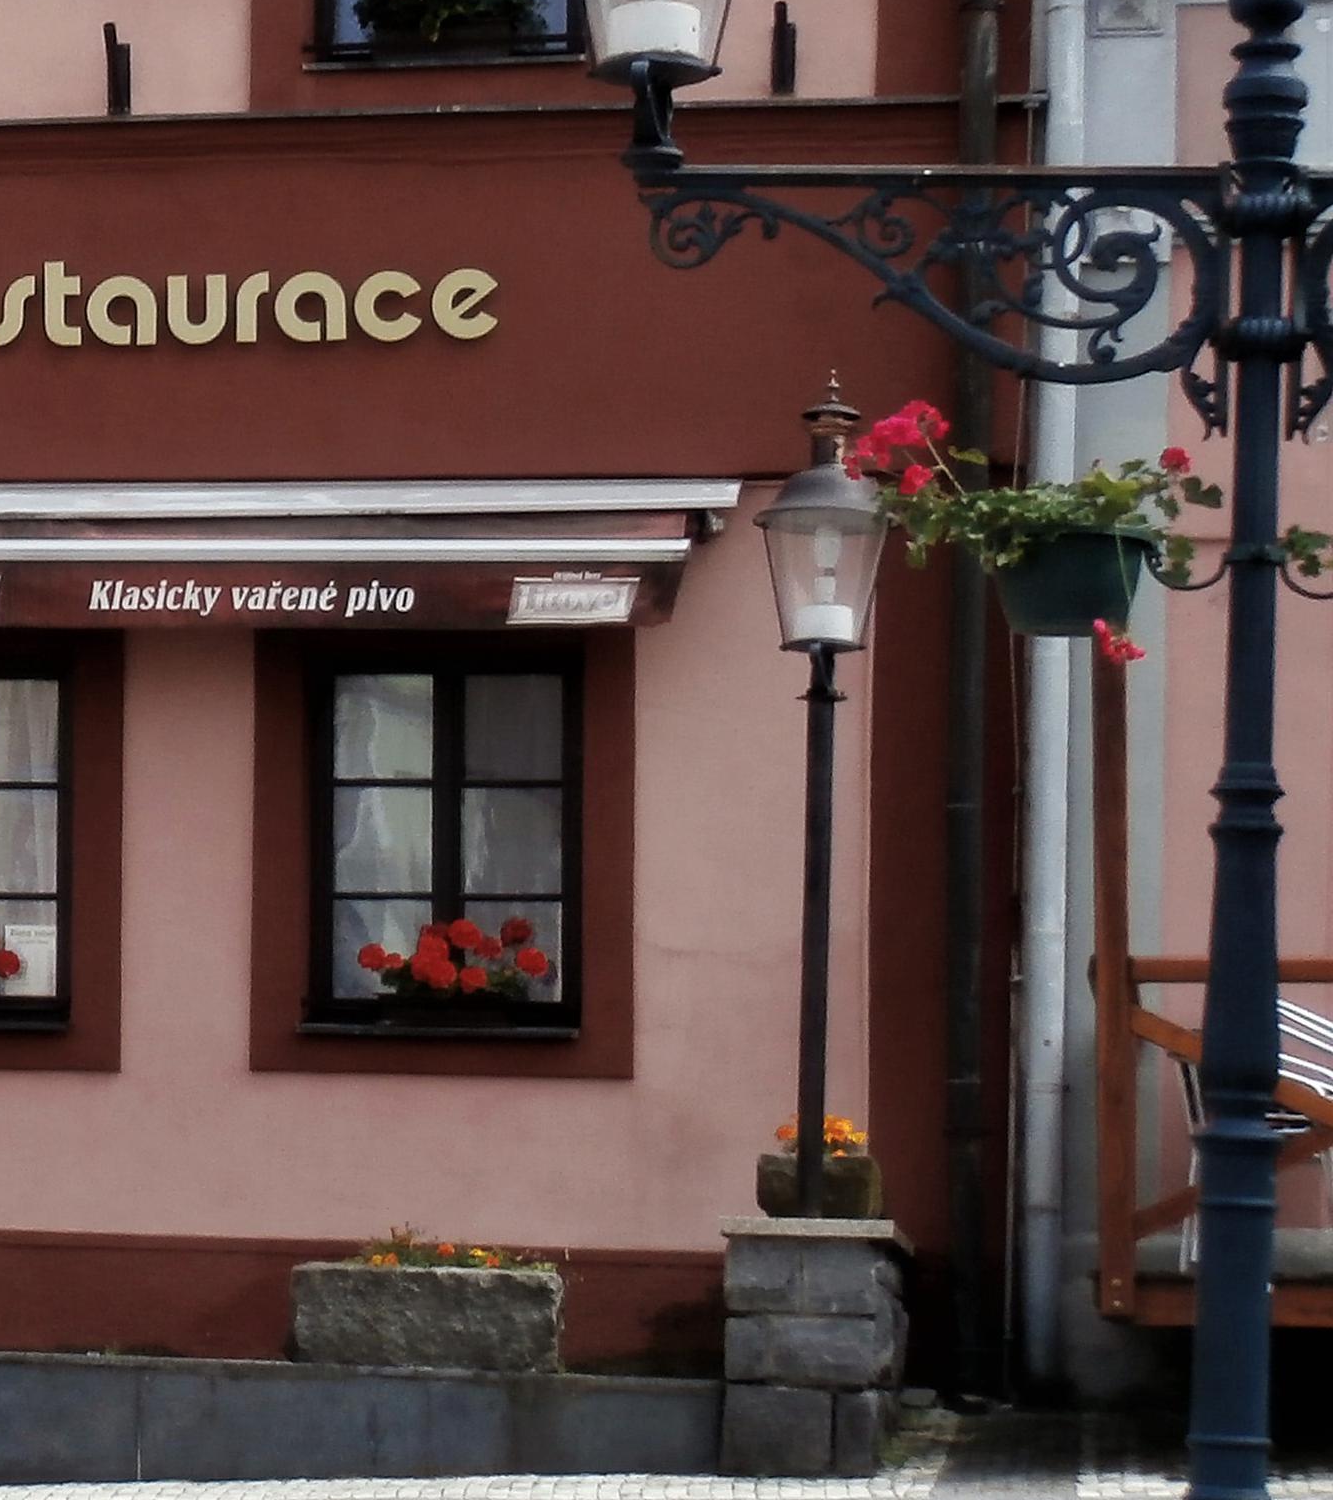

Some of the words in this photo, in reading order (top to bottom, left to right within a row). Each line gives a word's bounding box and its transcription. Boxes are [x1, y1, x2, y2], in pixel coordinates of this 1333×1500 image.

[88, 580, 221, 616] Klasicky
[231, 580, 338, 612] vařené
[343, 580, 416, 618] pivo
